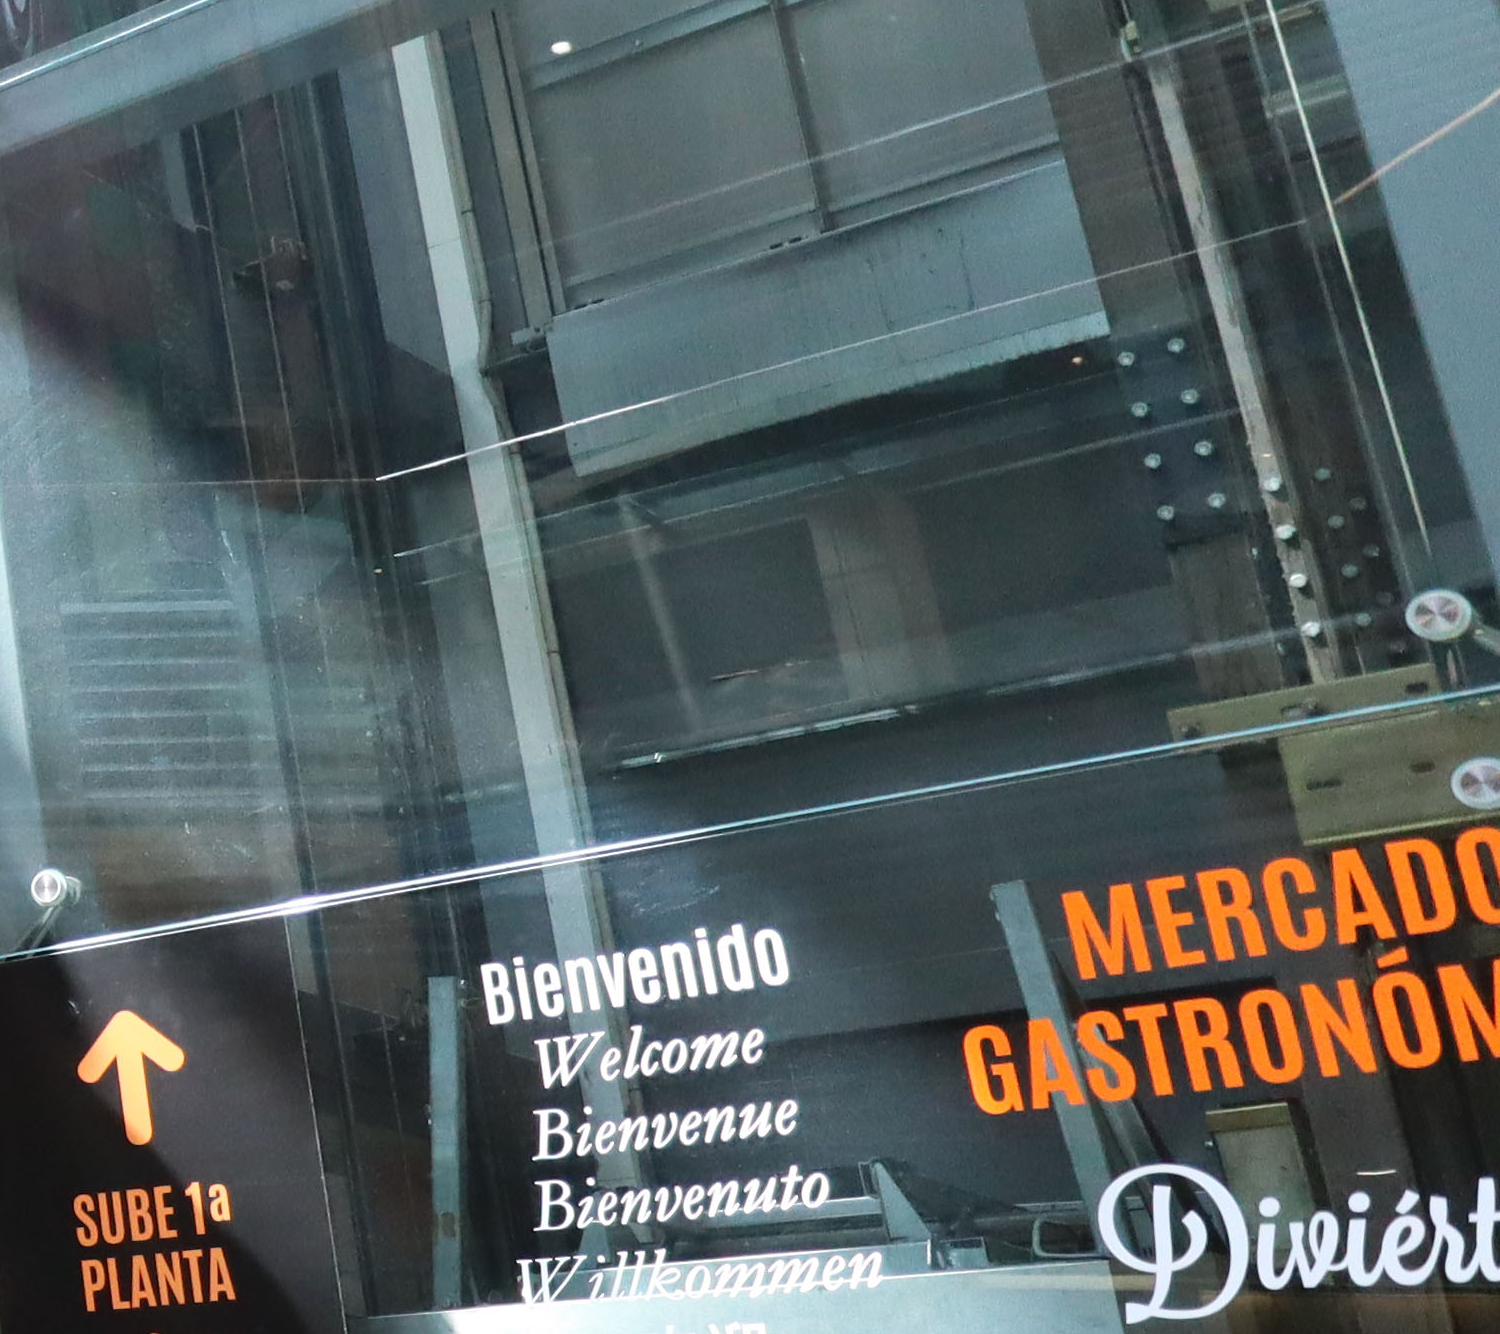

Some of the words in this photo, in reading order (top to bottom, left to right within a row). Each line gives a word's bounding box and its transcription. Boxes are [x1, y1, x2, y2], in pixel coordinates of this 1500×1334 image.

[1061, 826, 1500, 981] MERCADO
[480, 923, 790, 1026] Bienvenido
[534, 1025, 765, 1090] Welcome
[532, 1098, 799, 1161] Bienvenue
[73, 1184, 175, 1248] SUBE
[533, 1165, 830, 1232] Bienvenuto
[81, 1247, 236, 1312] PLANTA
[517, 1248, 883, 1307] Willkommen
